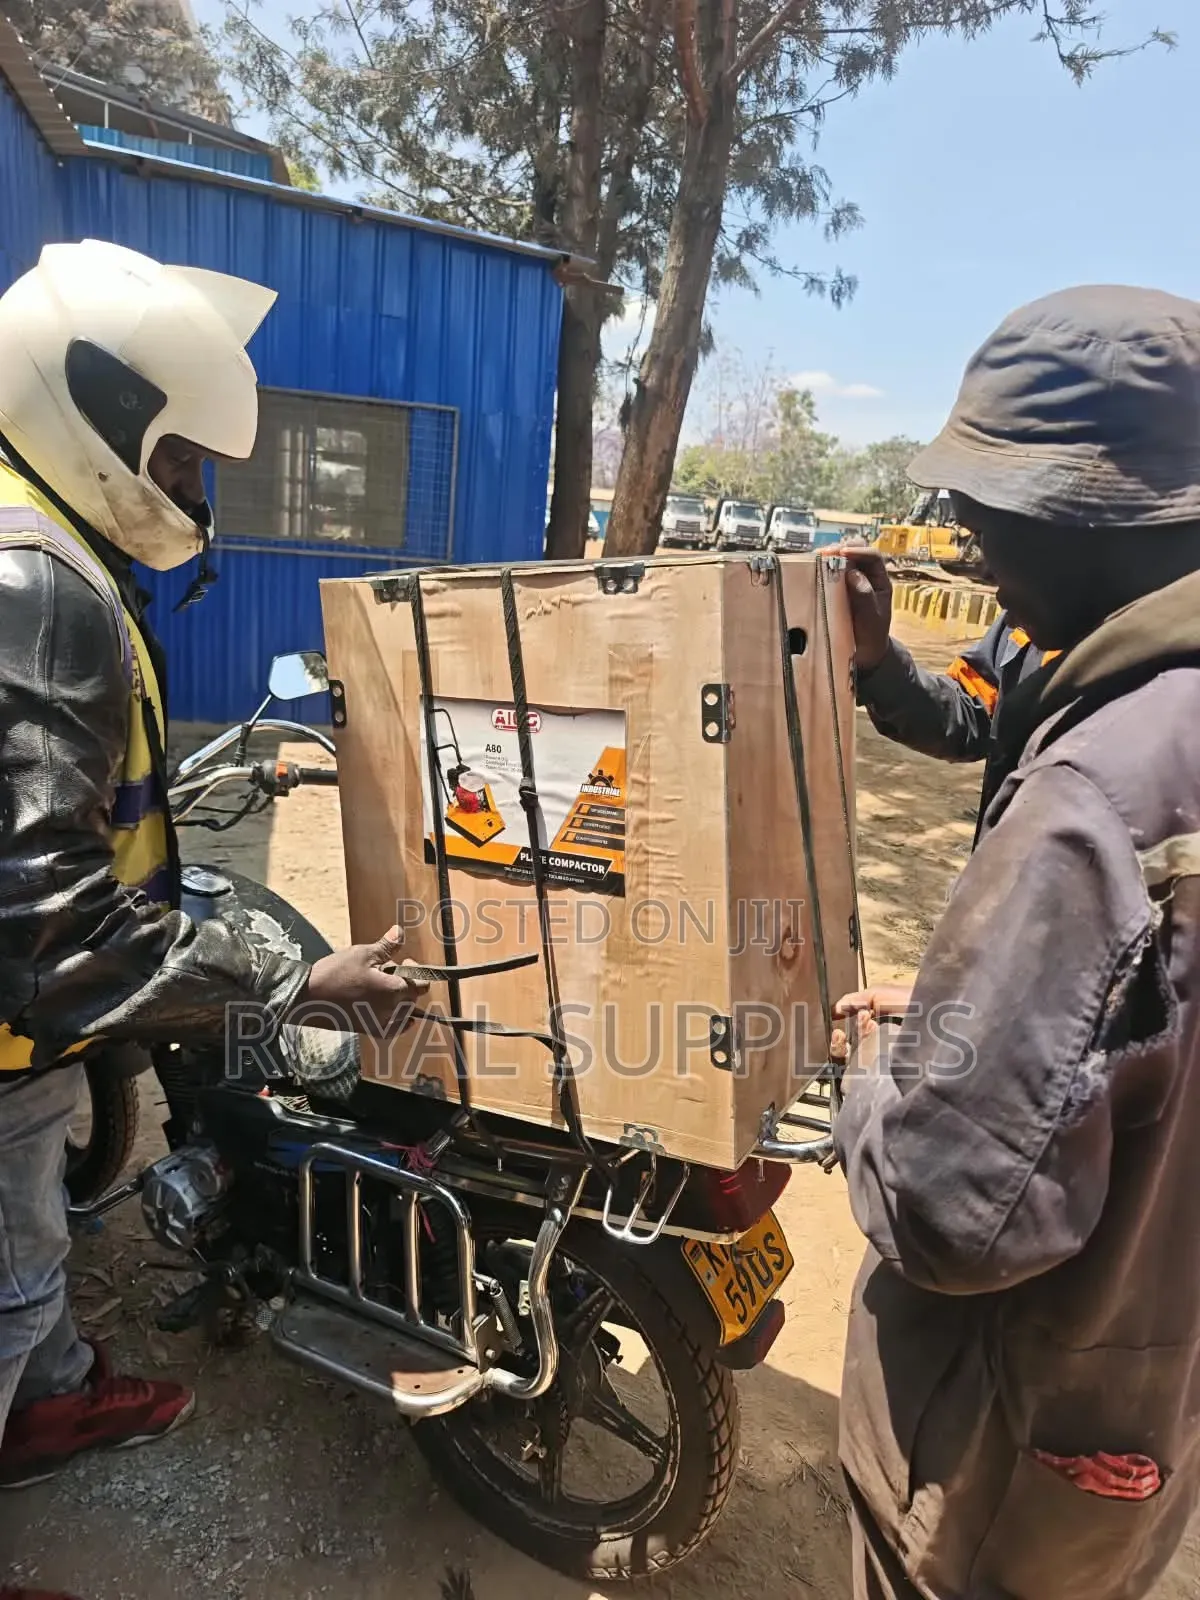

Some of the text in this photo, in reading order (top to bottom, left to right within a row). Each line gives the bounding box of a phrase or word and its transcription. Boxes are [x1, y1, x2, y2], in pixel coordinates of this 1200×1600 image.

[485, 743, 502, 754] A80
[580, 785, 621, 797] INDUSTRIAL
[520, 852, 547, 864] PLE
[548, 857, 605, 874] COMPACTOR
